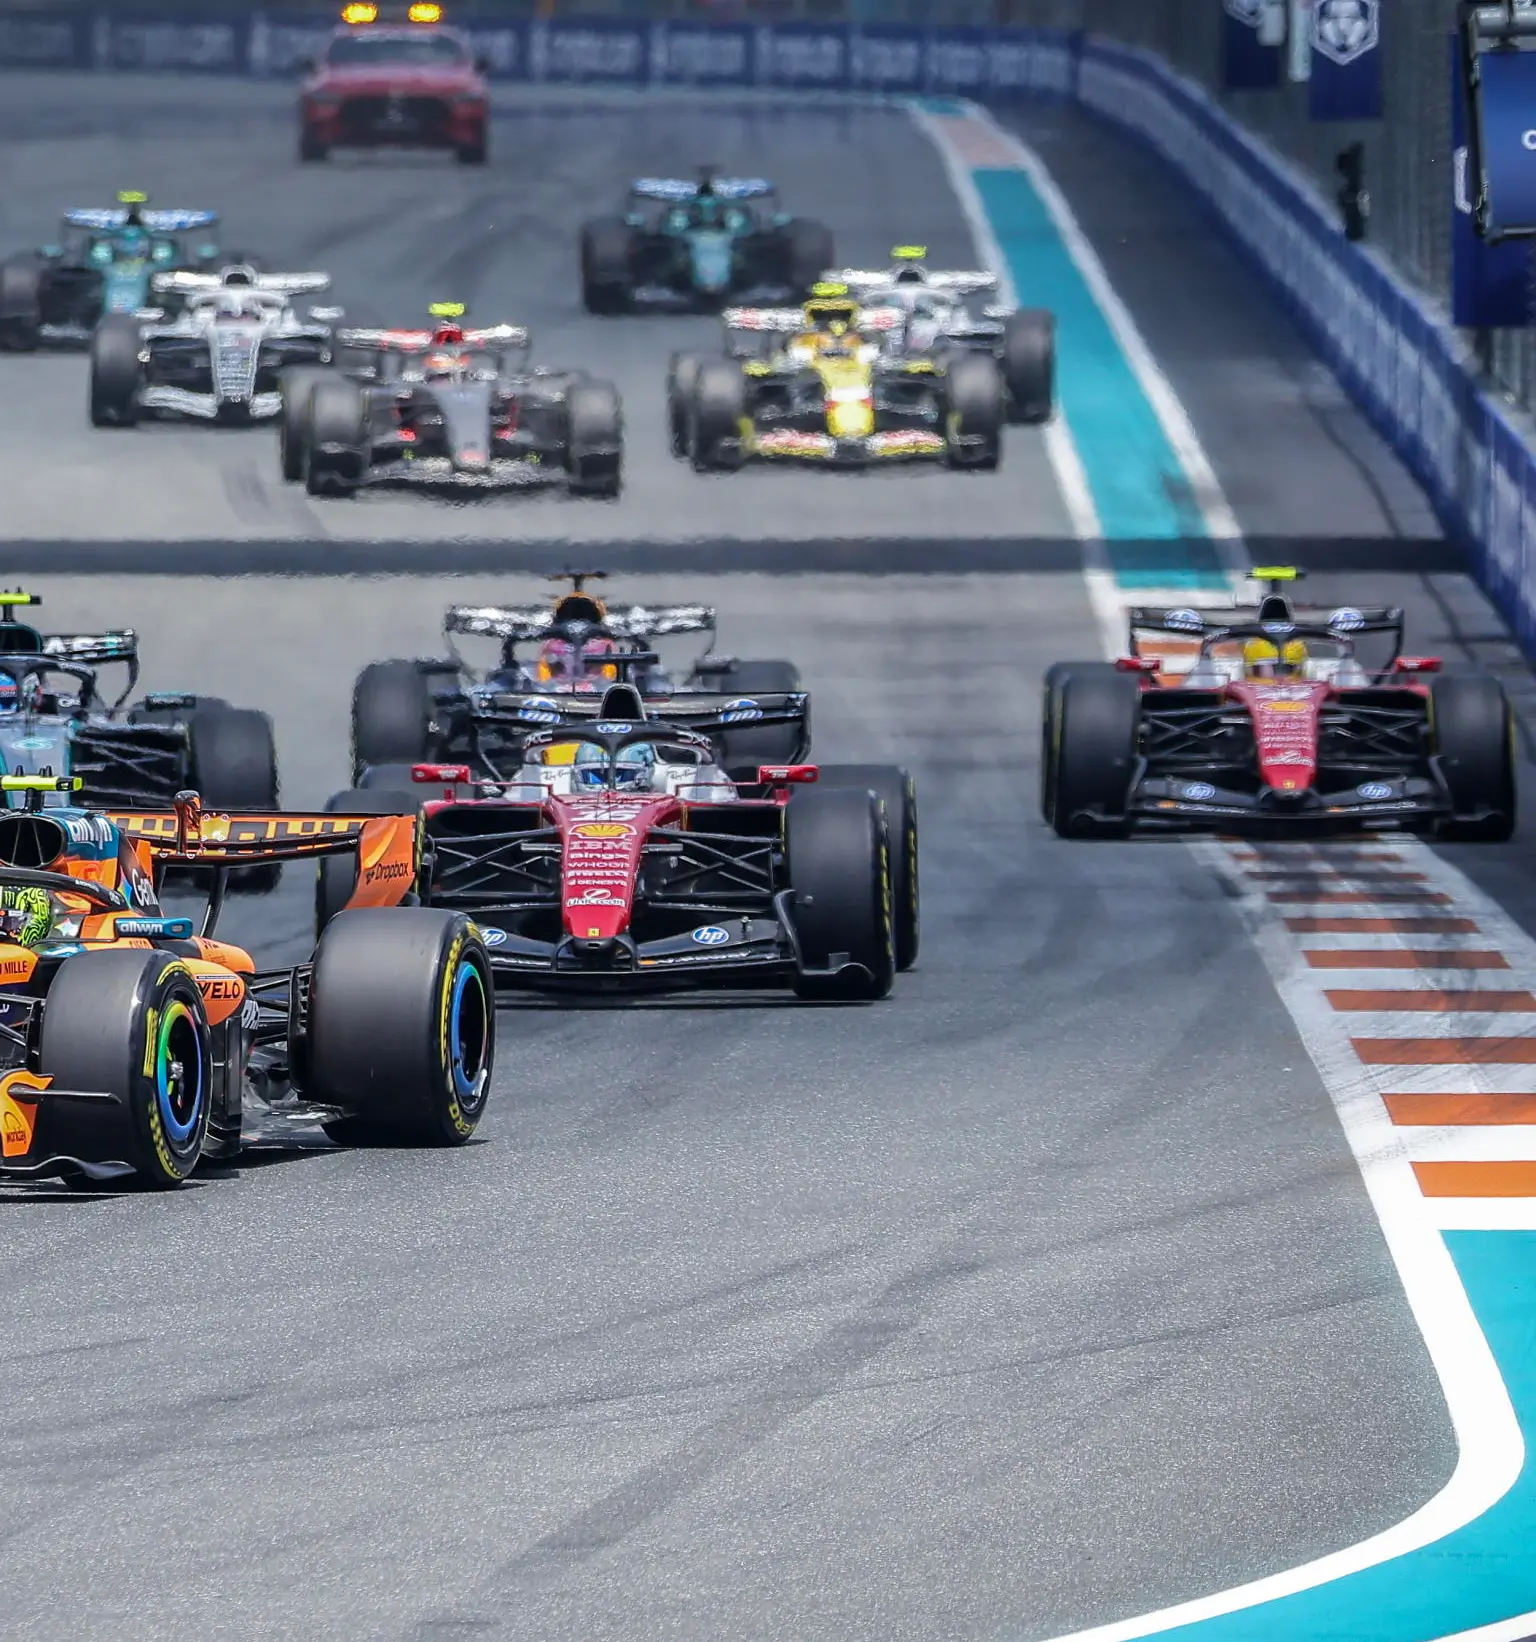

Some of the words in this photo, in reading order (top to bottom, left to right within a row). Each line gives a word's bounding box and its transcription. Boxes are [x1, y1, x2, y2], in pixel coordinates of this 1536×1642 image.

[569, 841, 633, 851] IBM
[374, 861, 410, 884] Dropbox
[119, 920, 163, 936] allwyn
[4, 960, 29, 975] MILLE
[198, 981, 241, 999] VELO
